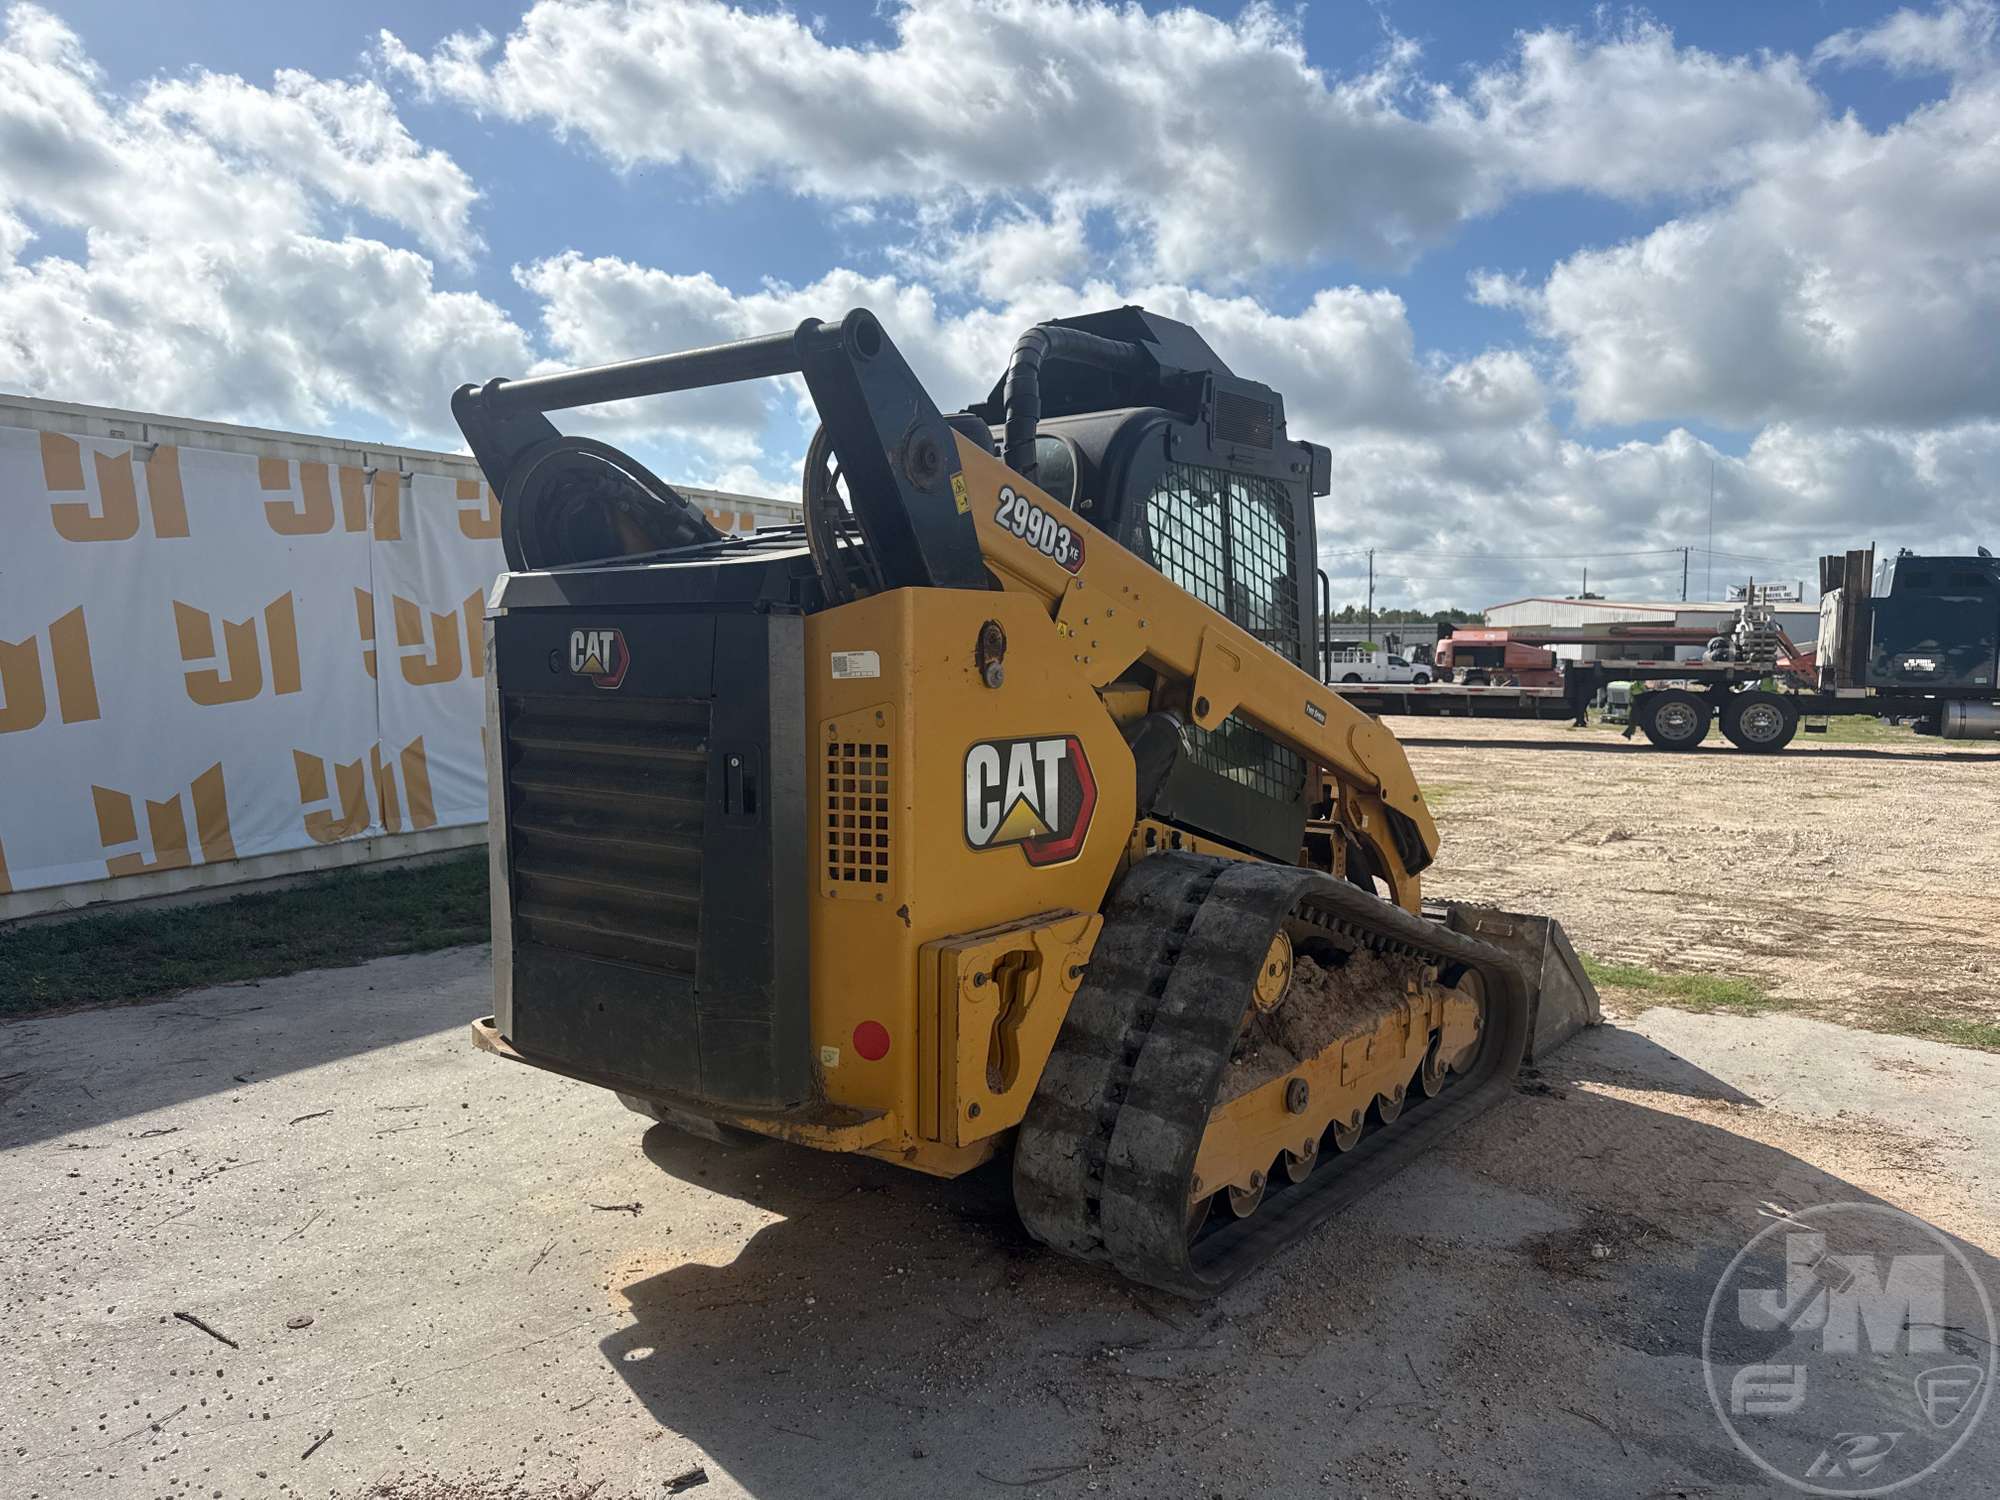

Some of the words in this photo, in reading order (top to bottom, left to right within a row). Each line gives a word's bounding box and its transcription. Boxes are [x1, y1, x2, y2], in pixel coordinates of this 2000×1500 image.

[996, 487, 1071, 564] 299D3
[1069, 546, 1079, 560] XE
[570, 631, 614, 673] CAT
[967, 739, 1066, 845] CAT
